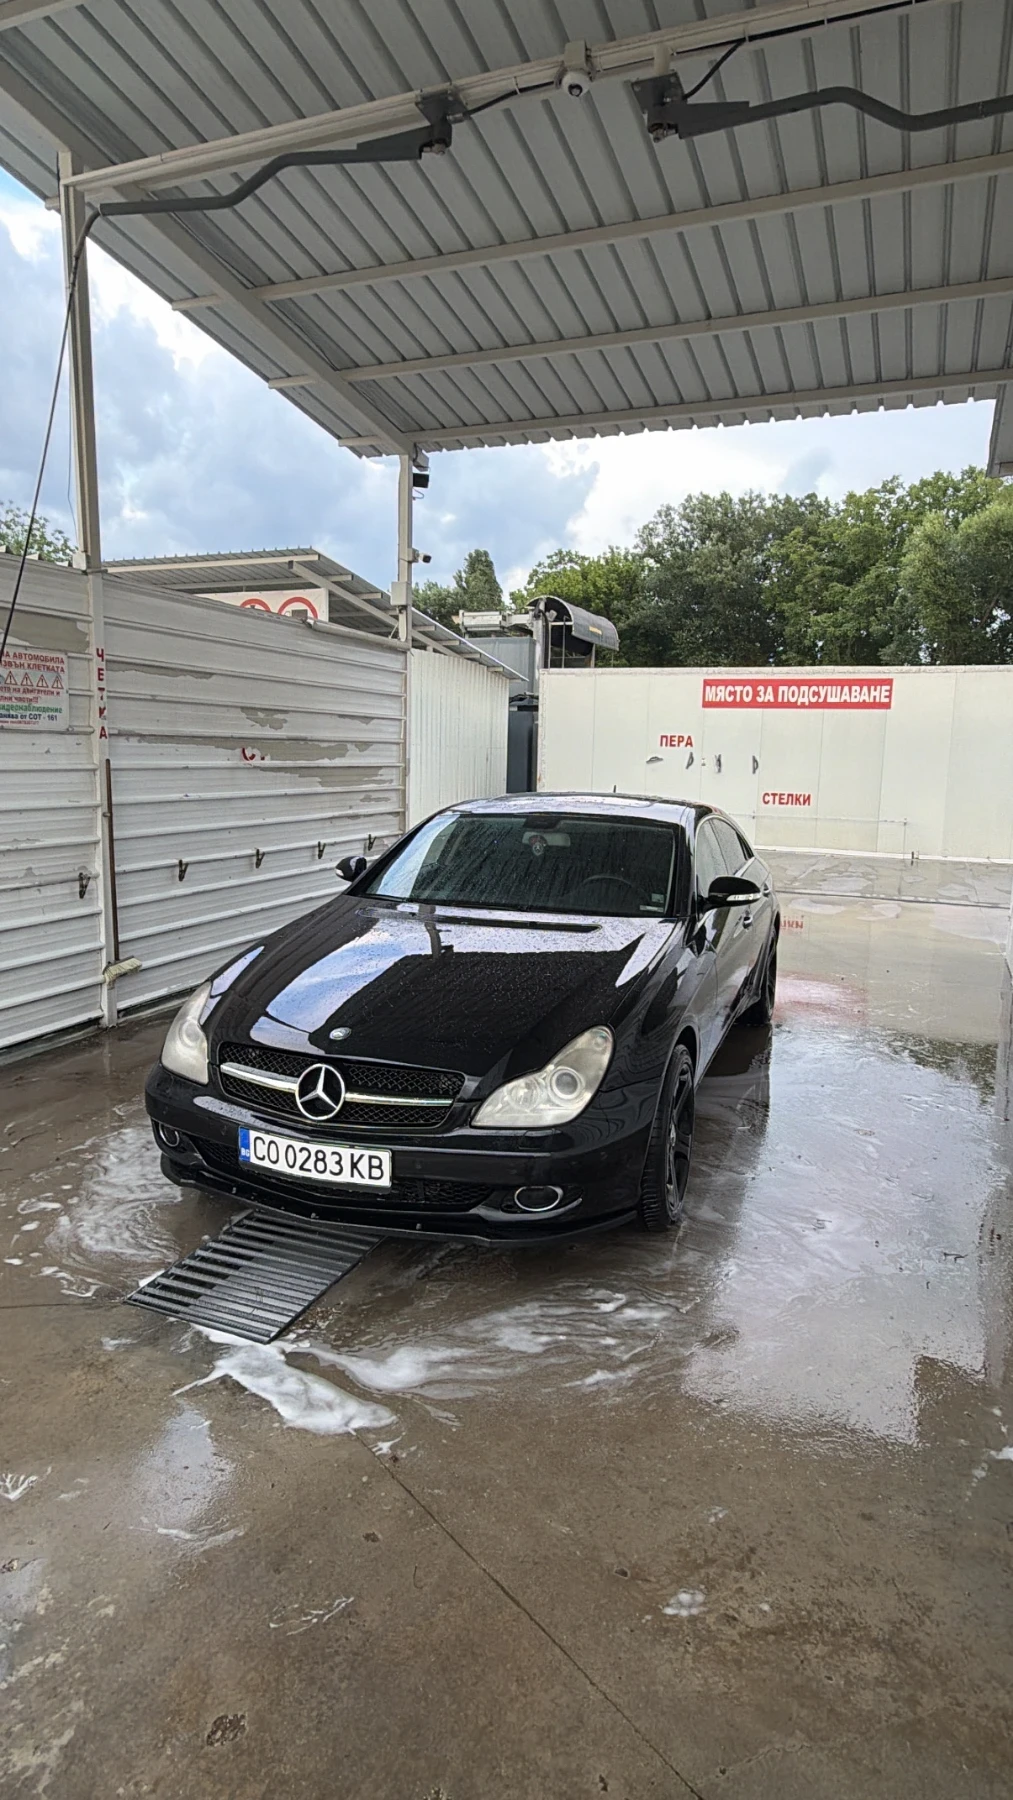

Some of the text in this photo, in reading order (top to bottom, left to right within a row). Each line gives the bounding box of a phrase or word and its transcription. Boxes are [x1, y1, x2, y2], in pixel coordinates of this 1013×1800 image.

[13, 651, 65, 665] АВТОМОБИЛА
[27, 662, 66, 674] КЛЕТКАТА
[705, 685, 891, 706] МЯСТО ЗА ПОДСУШАВАНЕ
[28, 713, 42, 721] СОТ
[660, 735, 693, 747] ПЕРА
[762, 793, 811, 806] СТЕЛКИ
[285, 1144, 344, 1176] 0283
